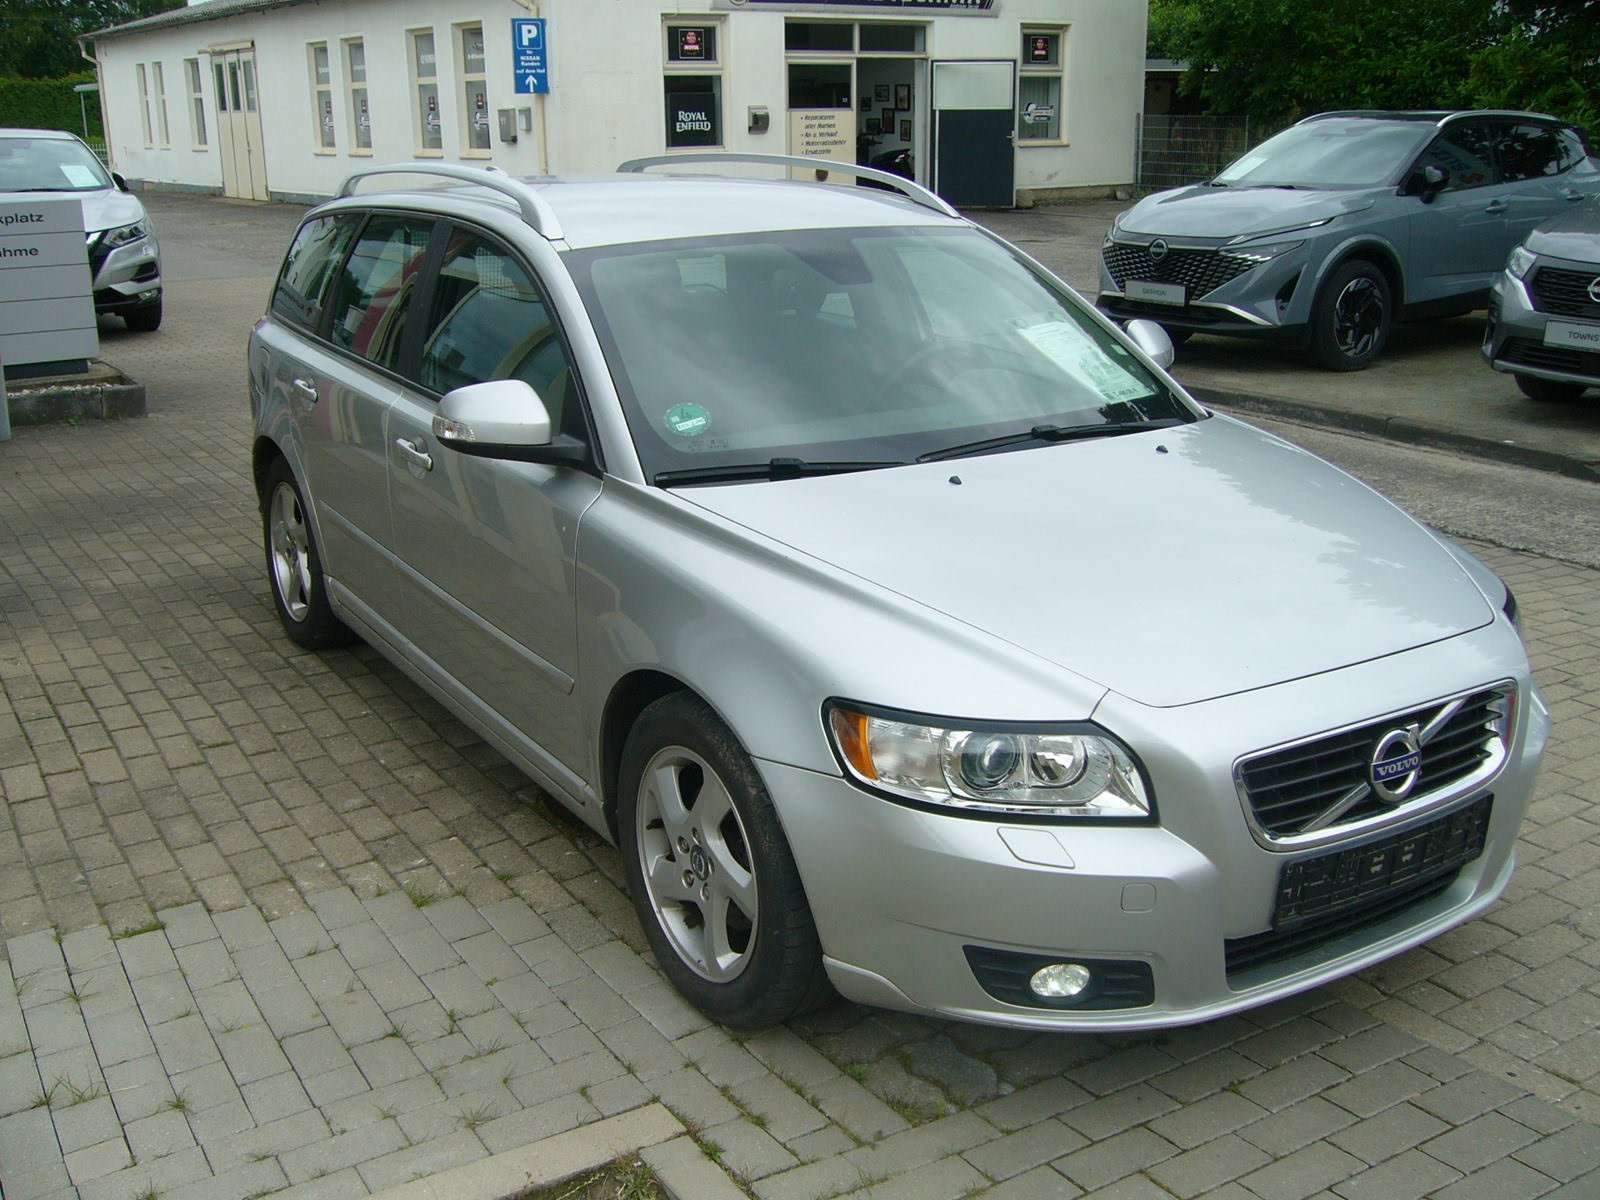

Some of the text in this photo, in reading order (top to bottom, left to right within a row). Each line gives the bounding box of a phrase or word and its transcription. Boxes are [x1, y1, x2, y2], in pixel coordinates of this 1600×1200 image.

[521, 24, 538, 46] P
[678, 111, 707, 121] ROYAL
[676, 121, 711, 132] ENFIELD
[1377, 756, 1419, 776] VOLVO
